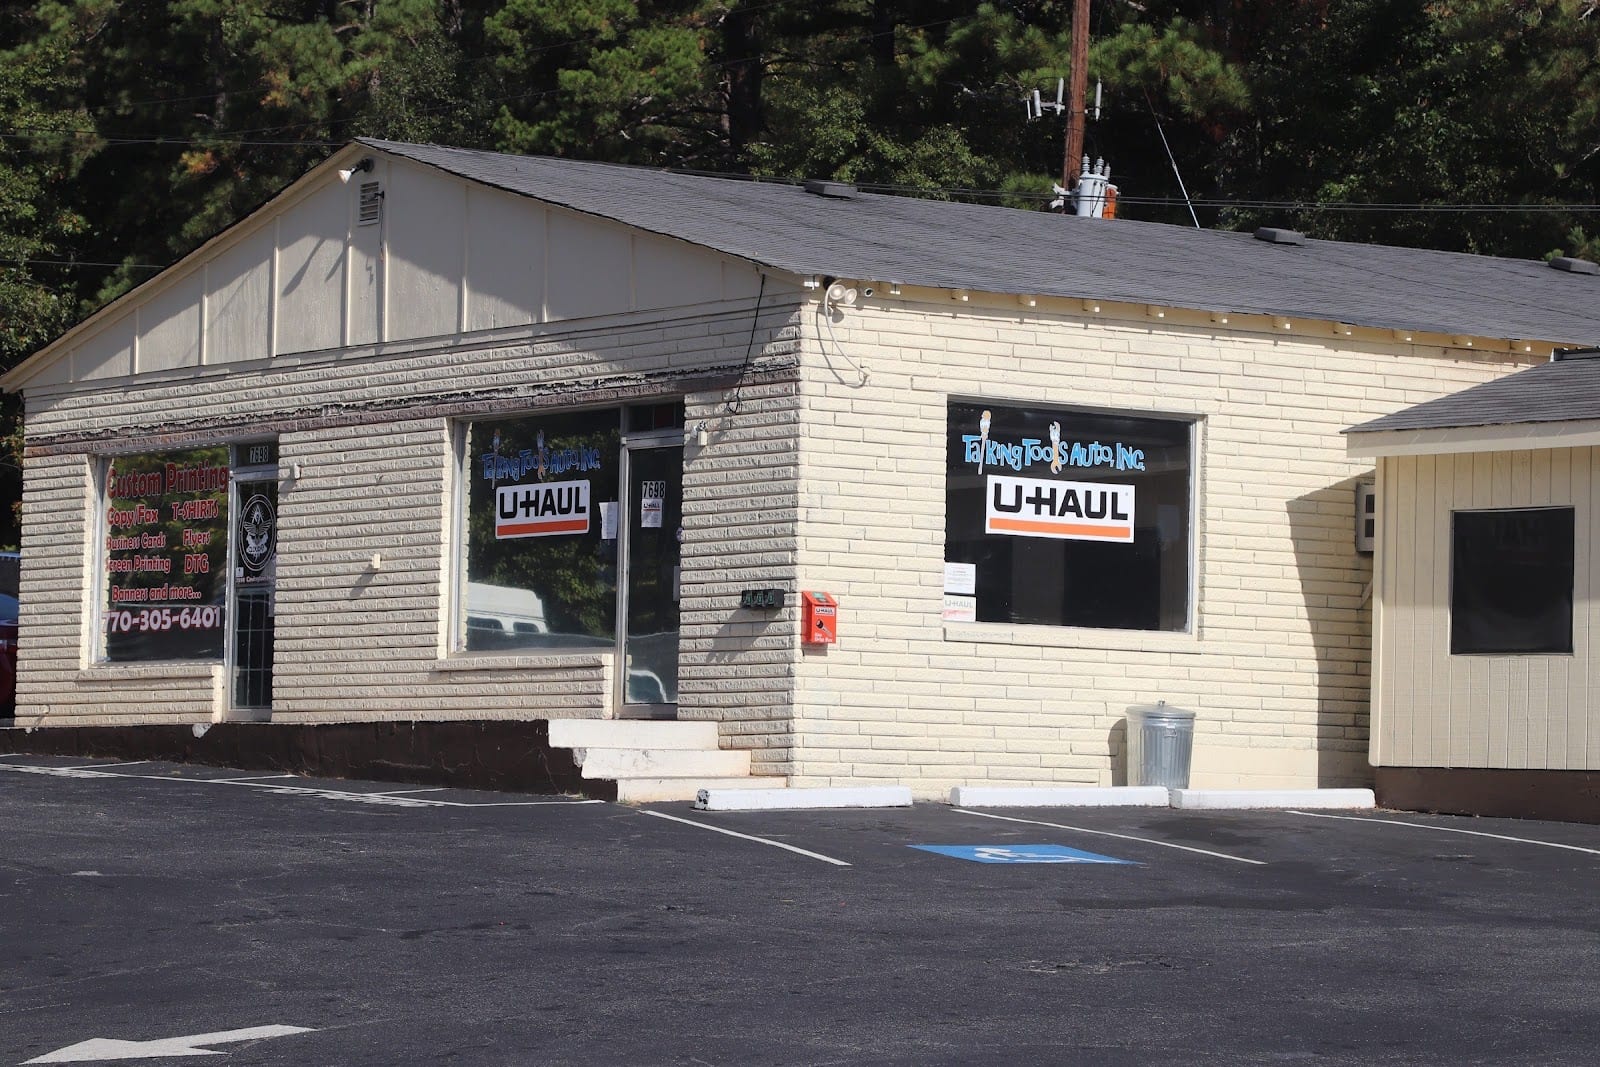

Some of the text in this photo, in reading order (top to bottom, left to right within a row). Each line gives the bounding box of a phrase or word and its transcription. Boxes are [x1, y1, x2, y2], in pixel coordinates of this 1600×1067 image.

[250, 446, 268, 463] 7698
[106, 460, 229, 499] Custom Printing
[643, 481, 665, 498] 7698
[172, 499, 219, 520] T-SHIRTS
[500, 486, 587, 519] U-HAUL
[993, 482, 1129, 521] U-HAUL
[107, 504, 158, 529] Copy/Fax
[106, 532, 166, 551] Business Cards
[183, 529, 211, 548] Flyers
[105, 554, 171, 574] Screen Printing
[184, 553, 209, 574] DTG
[112, 585, 148, 602] Banners
[149, 583, 168, 600] and
[101, 606, 220, 632] 770-305-6401
